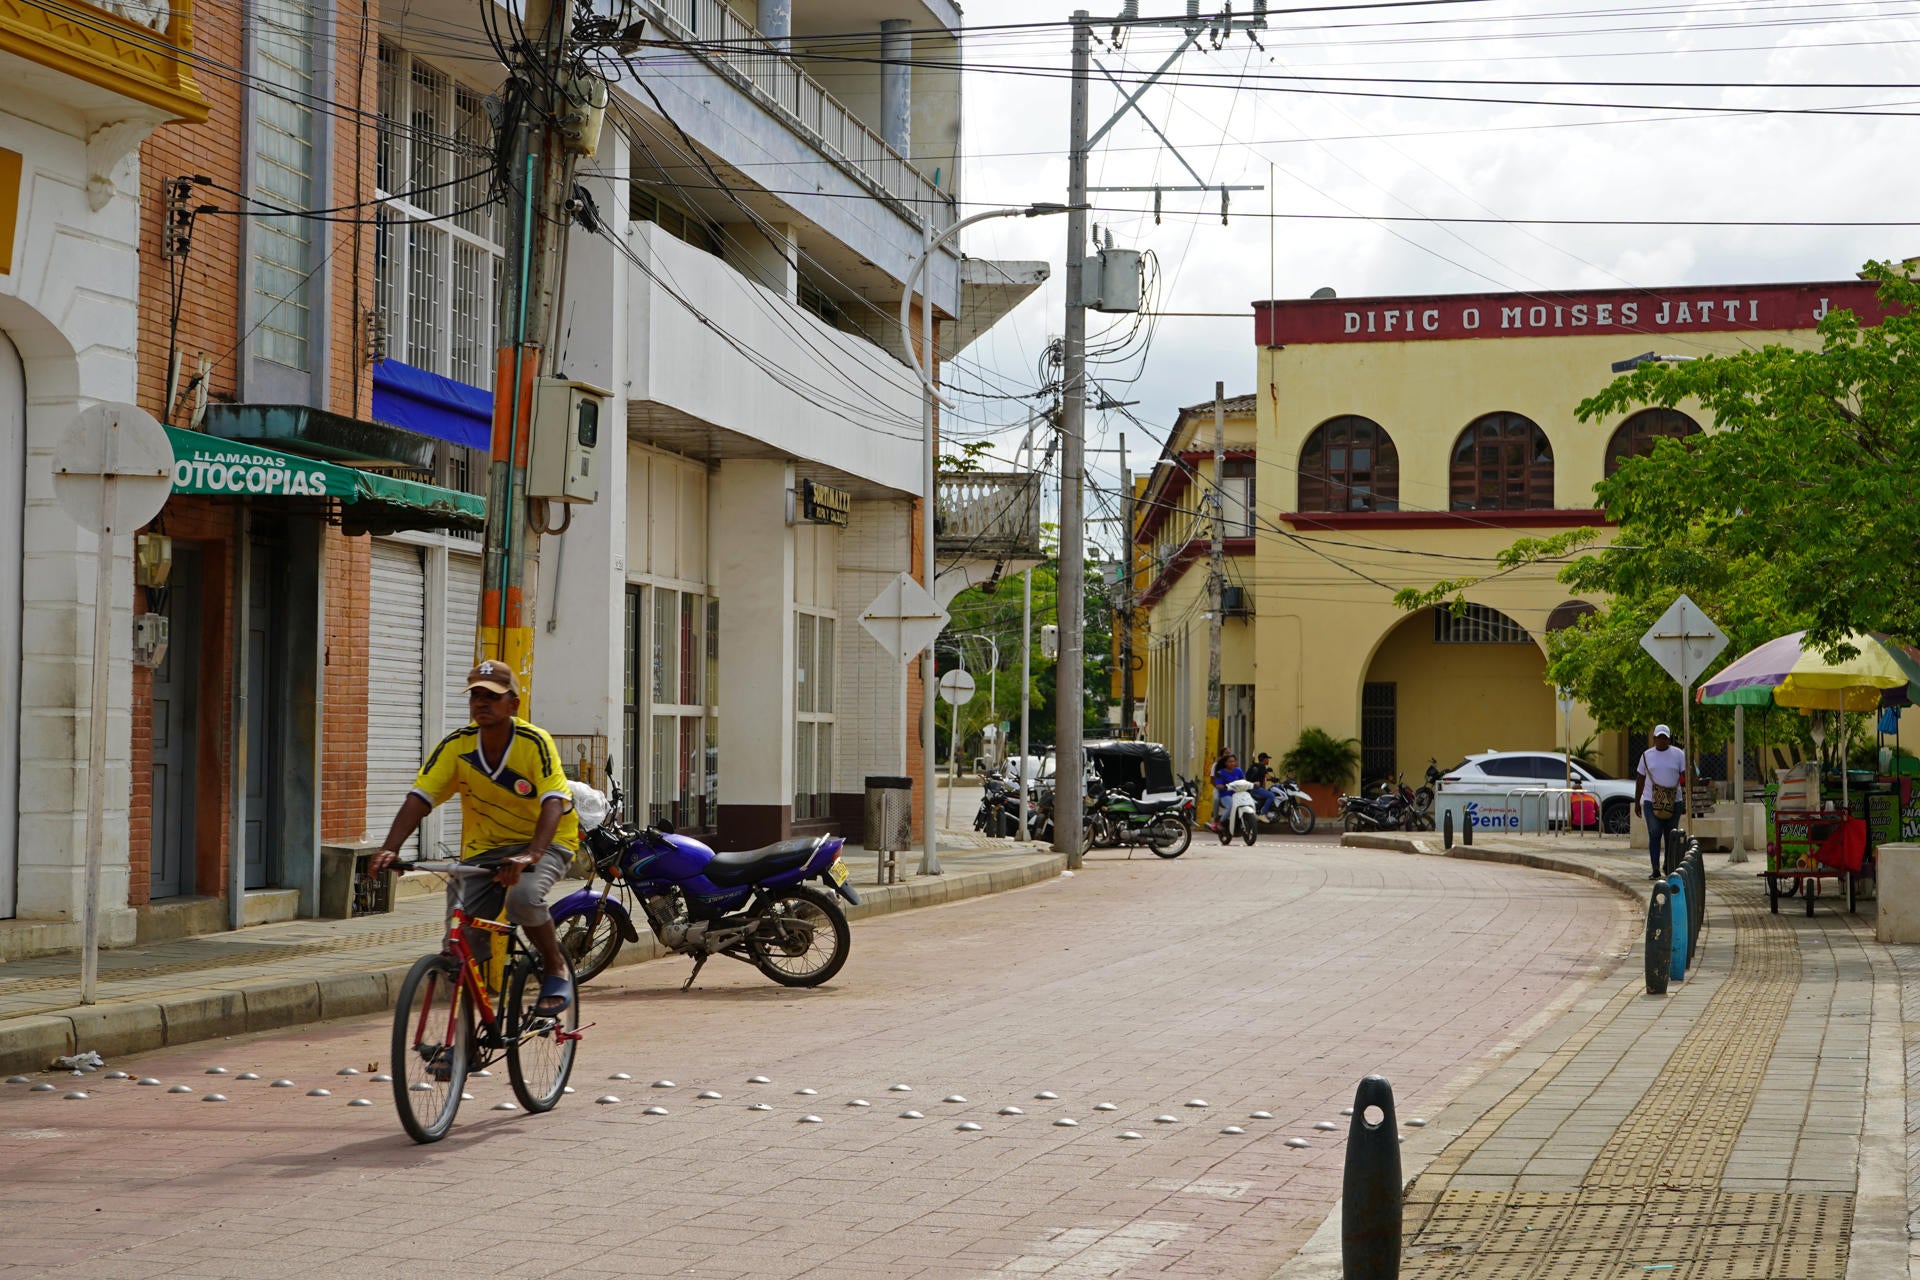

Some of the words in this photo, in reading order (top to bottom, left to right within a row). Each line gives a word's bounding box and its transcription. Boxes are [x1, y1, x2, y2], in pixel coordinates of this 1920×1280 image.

[1500, 302, 1639, 329] MOISES
[1655, 299, 1759, 325] JATTI
[193, 450, 287, 468] LLAMADAS
[173, 459, 327, 496] OTOCOPIAS
